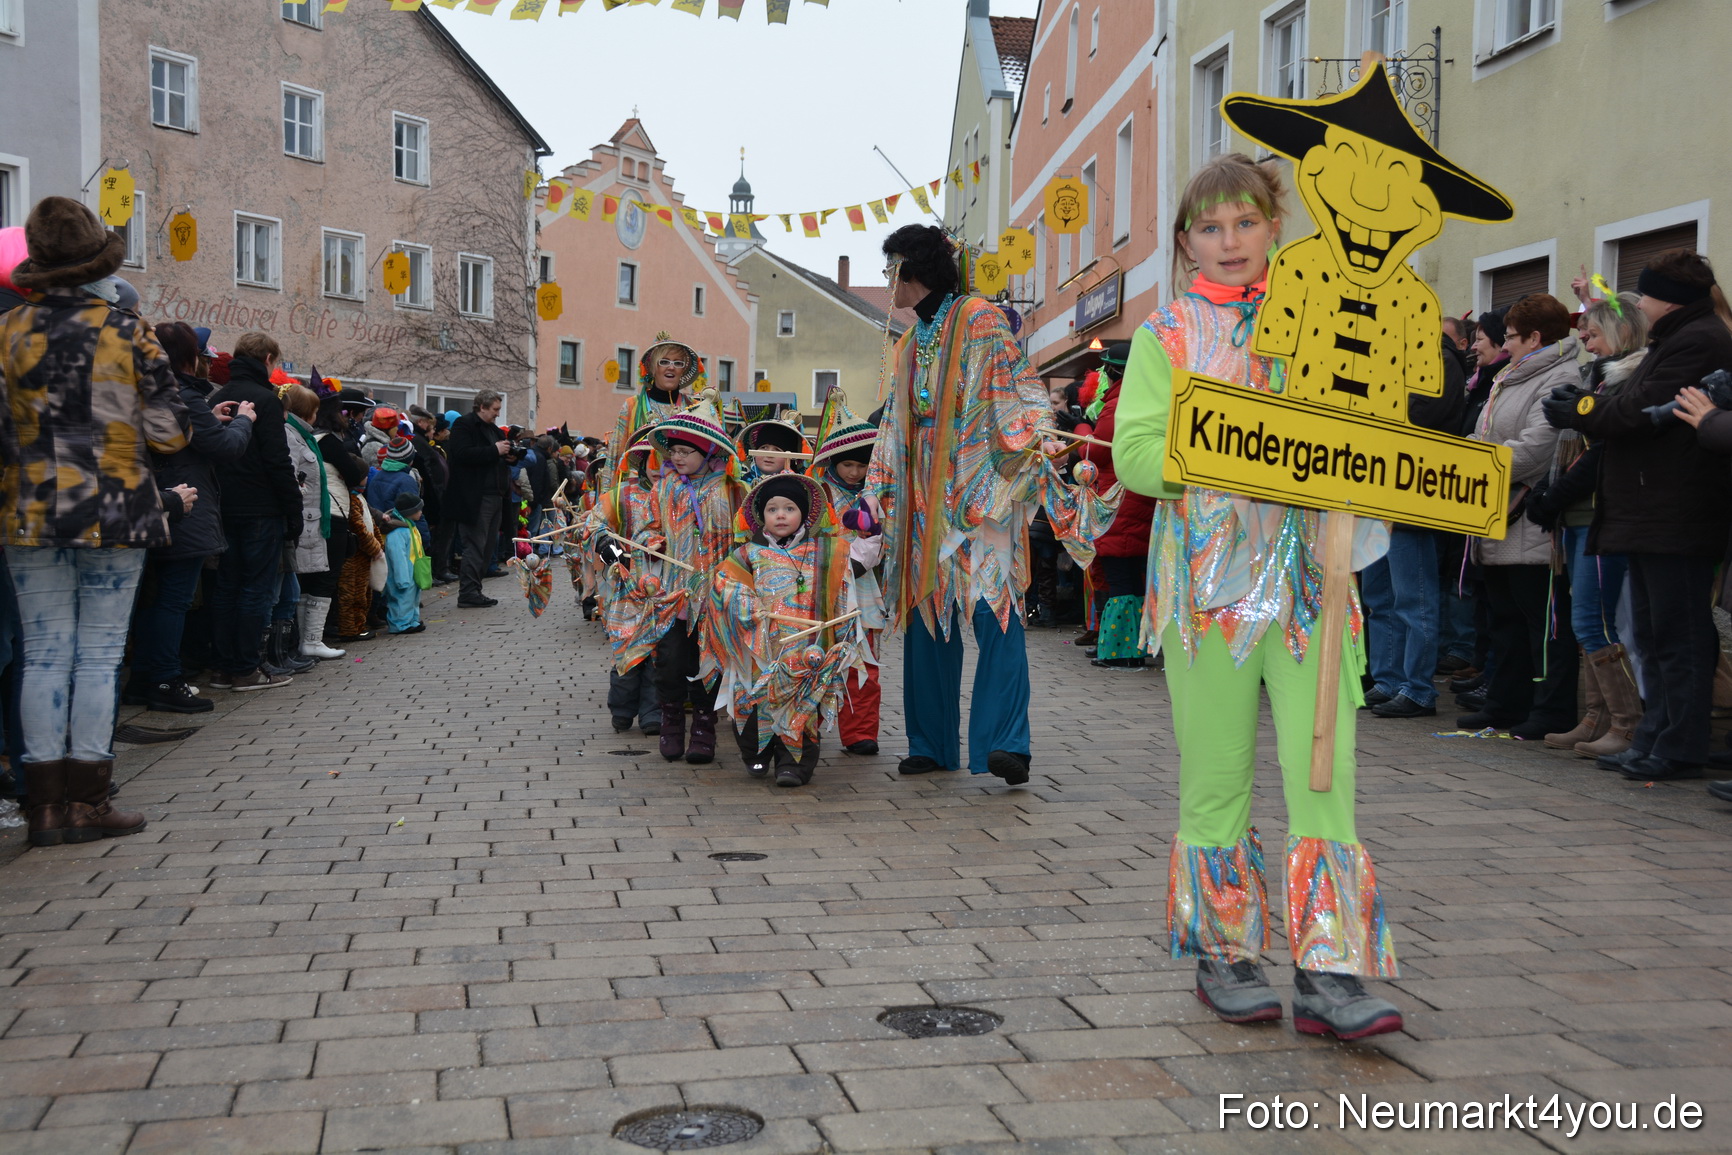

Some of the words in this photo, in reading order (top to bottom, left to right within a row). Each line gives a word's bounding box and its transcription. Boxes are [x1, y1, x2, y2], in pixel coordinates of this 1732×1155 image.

[149, 284, 278, 332] Konditorei
[1189, 406, 1386, 487] Kindergarten
[1395, 451, 1489, 508] Dietfurt
